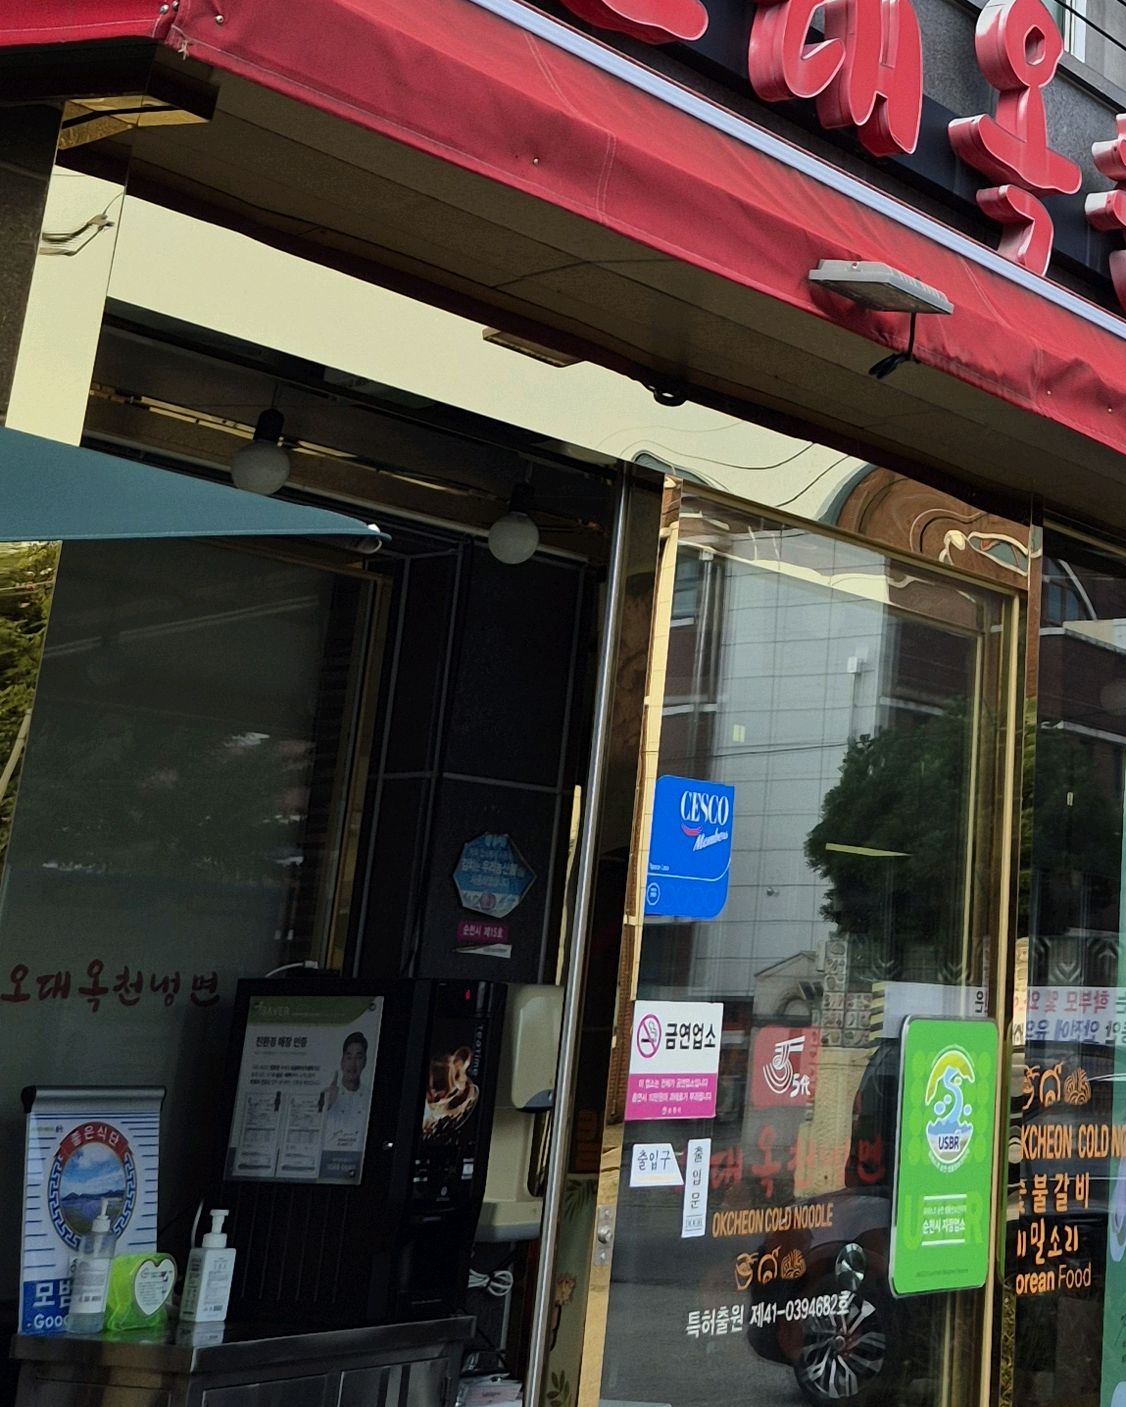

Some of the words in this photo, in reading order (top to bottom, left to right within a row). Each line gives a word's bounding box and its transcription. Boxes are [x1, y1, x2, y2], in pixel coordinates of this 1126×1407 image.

[680, 791, 729, 825] CESCO
[665, 1023, 716, 1050] 금연업소
[938, 1135, 959, 1150] USBR
[1020, 1123, 1072, 1161] KCHEON
[1078, 1124, 1108, 1158] COLD
[637, 1148, 672, 1171] 출입구
[691, 1146, 705, 1211] 출입문
[712, 1209, 765, 1238] OKCHEON
[765, 1206, 792, 1232] COLD
[793, 1202, 834, 1230] NOODLE
[1016, 1269, 1055, 1295] orean
[1057, 1262, 1092, 1289] Food
[686, 1304, 745, 1339] 특허출원
